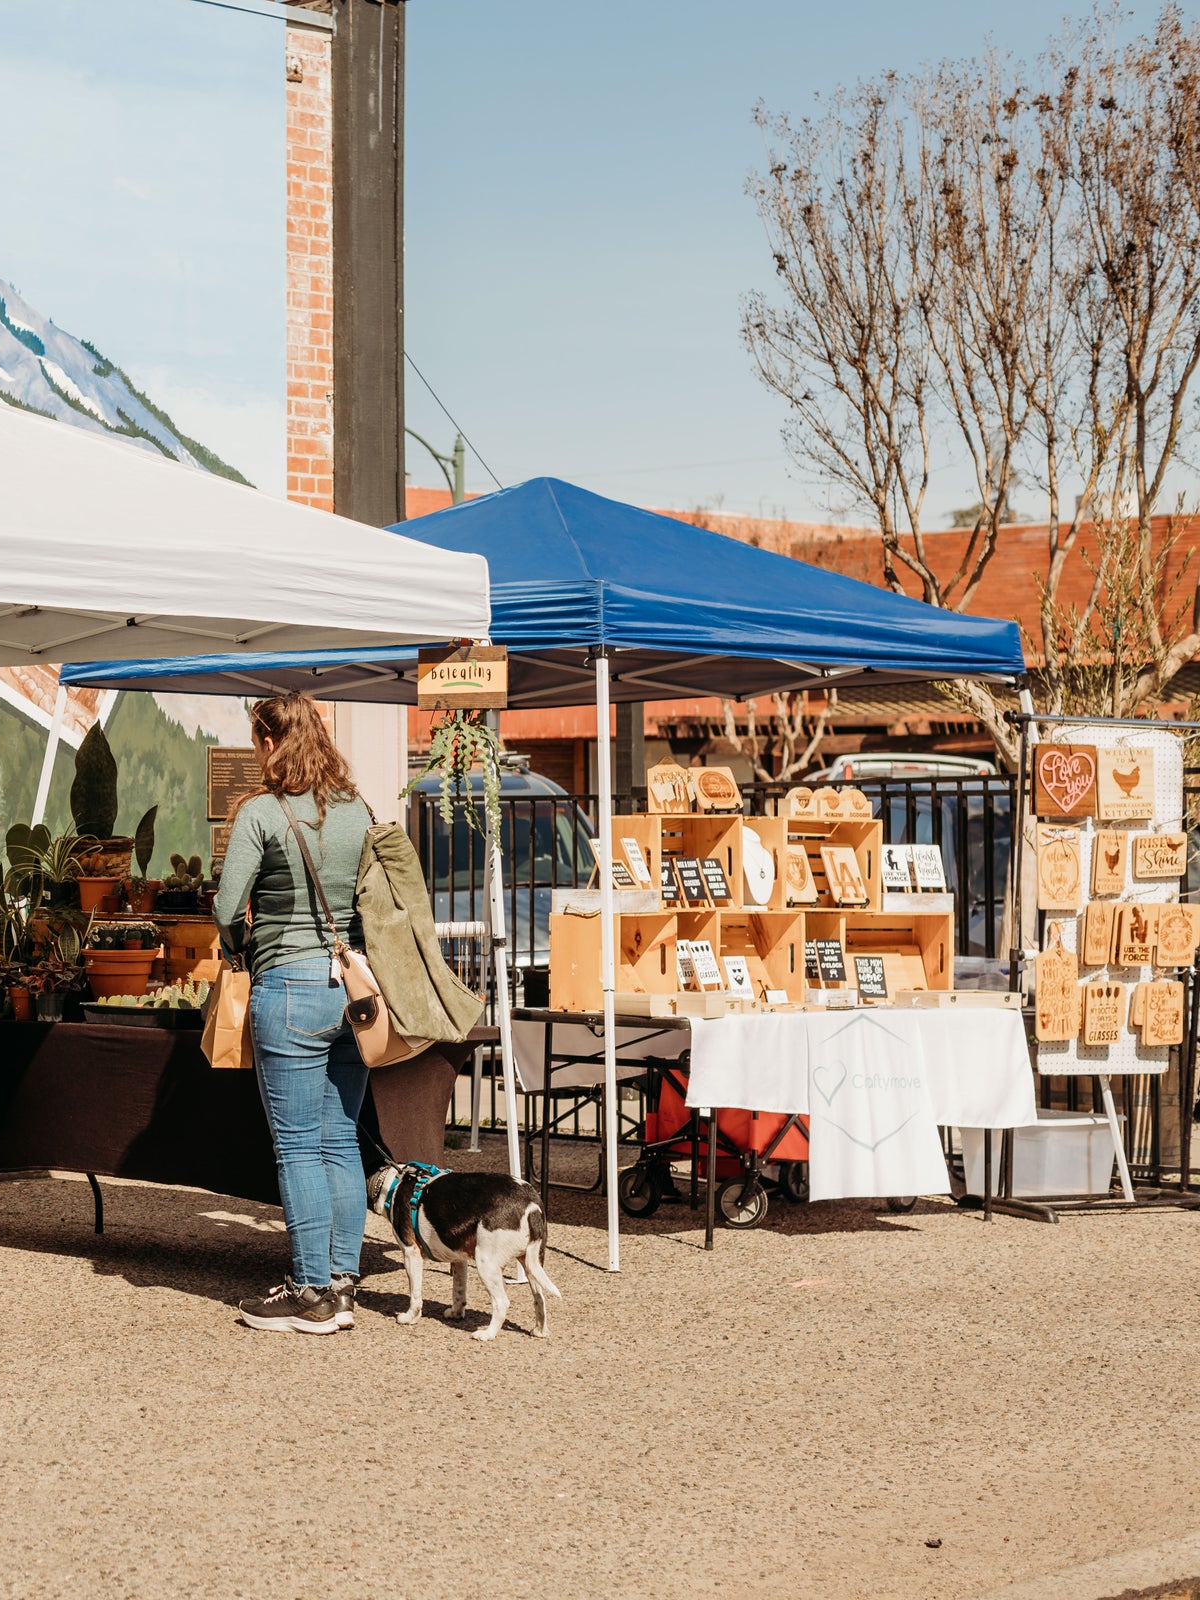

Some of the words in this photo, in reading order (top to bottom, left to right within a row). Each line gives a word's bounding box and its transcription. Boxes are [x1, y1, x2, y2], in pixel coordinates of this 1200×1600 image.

[1043, 753, 1081, 789] Love
[1062, 774, 1092, 806] you
[1105, 809, 1154, 818] KITCHEN
[1144, 849, 1179, 869] Shine
[1123, 954, 1150, 962] FORCE
[1088, 1030, 1119, 1042] GLASSES
